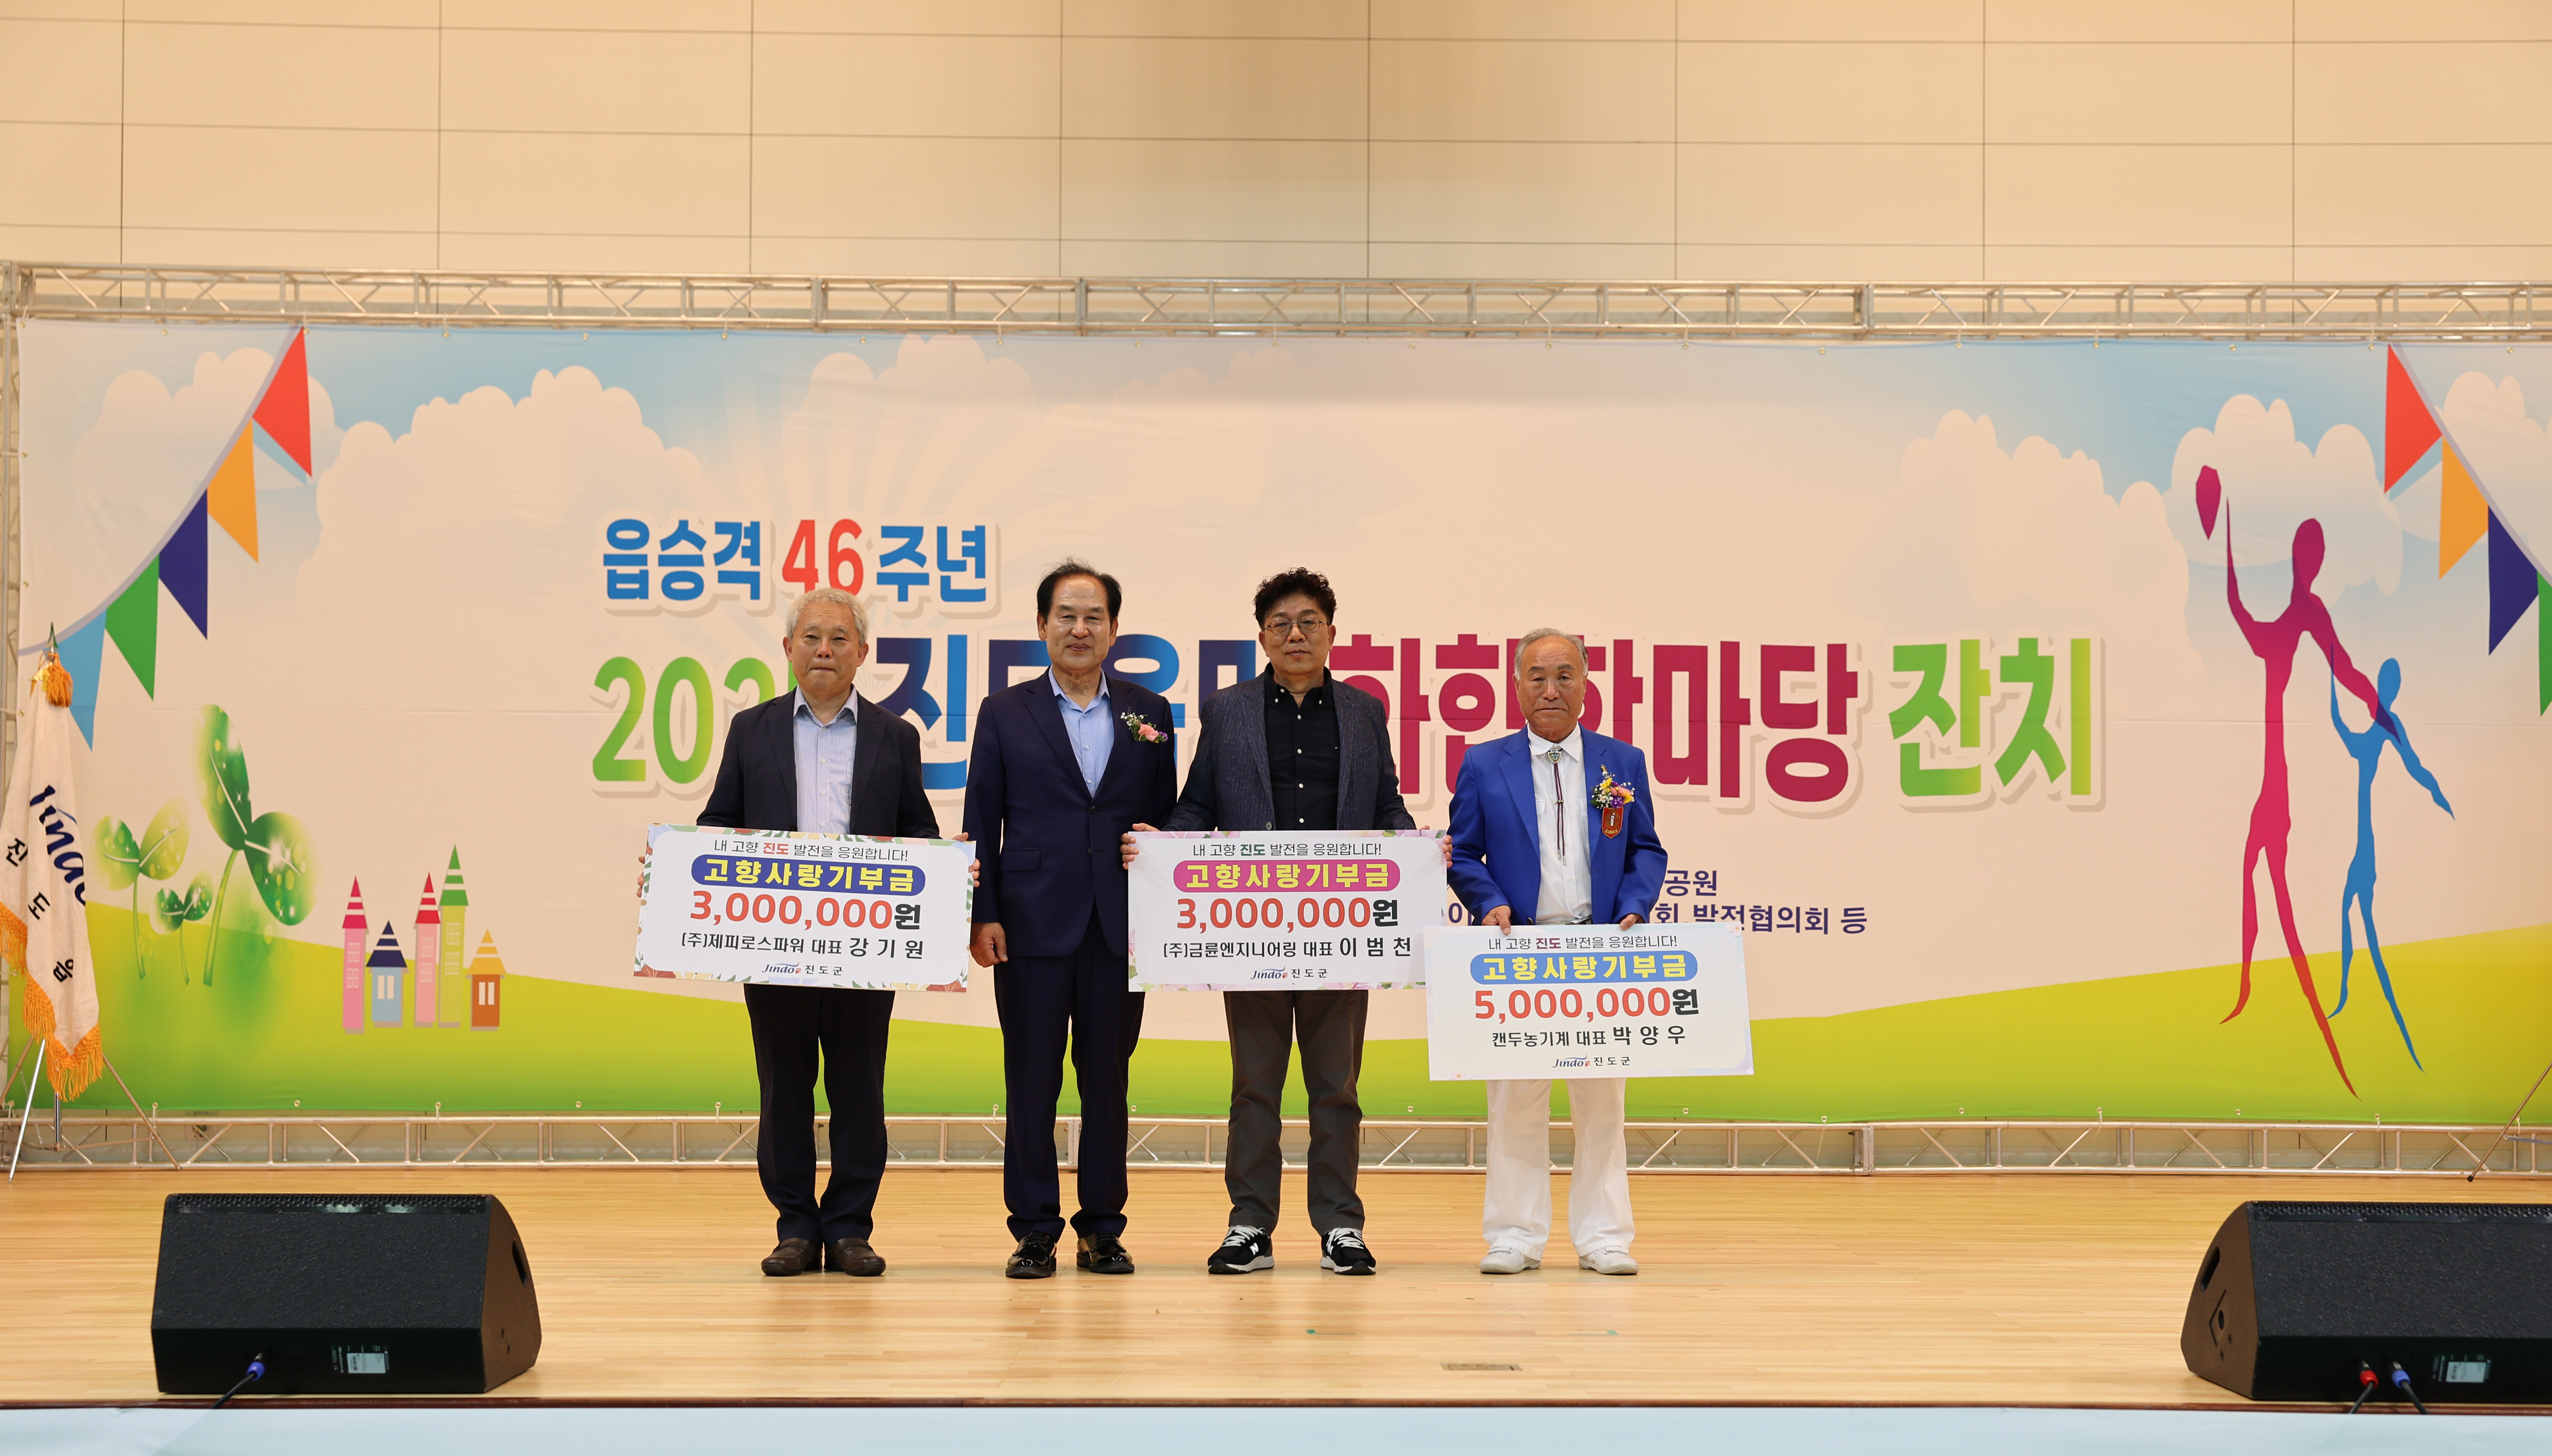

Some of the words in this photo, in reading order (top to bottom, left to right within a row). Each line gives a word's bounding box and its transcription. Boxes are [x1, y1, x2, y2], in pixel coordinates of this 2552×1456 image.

[604, 520, 759, 600] 읍승격
[782, 519, 863, 596] 46
[877, 526, 985, 601] 주년
[1890, 639, 2091, 796] 잔치
[715, 840, 726, 851] 내
[732, 841, 758, 853] 고향
[764, 843, 788, 854] 진도
[795, 845, 833, 857] 발전을
[837, 846, 908, 862] 응원합니다!
[1194, 845, 1205, 856] 내
[1210, 844, 1236, 856] 고향
[1241, 845, 1265, 856] 진도
[1271, 844, 1308, 856] 발전을
[1313, 843, 1381, 855] 응원합니다!
[704, 858, 914, 891] 고향사랑기부금
[1186, 863, 1388, 888] 고향사랑기부금
[1664, 870, 1717, 896] 공원
[690, 890, 921, 930] 3,000,000원
[1177, 898, 1398, 933] 3,000,000원
[1841, 907, 1867, 933] 등
[682, 933, 803, 953] (주)제피로스파워
[812, 940, 841, 954] 대표
[1164, 942, 1296, 958] (주)금륜엔지니어링
[1304, 942, 1332, 956] 대표
[1489, 938, 1500, 950] 내
[1505, 936, 1531, 950] 고향
[1536, 938, 1561, 949] 진도
[1566, 937, 1604, 948] 발전을
[1609, 936, 1677, 948] 응원합니다!
[762, 964, 795, 974] Jindo
[1250, 970, 1282, 979] Jindo
[1483, 956, 1685, 979] 고향사랑기부금
[1476, 988, 1698, 1024] 5,000,000원
[1492, 1032, 1569, 1046] 캔두농기계
[1577, 1031, 1606, 1045] 대표
[1553, 1058, 1584, 1068] Jindo
